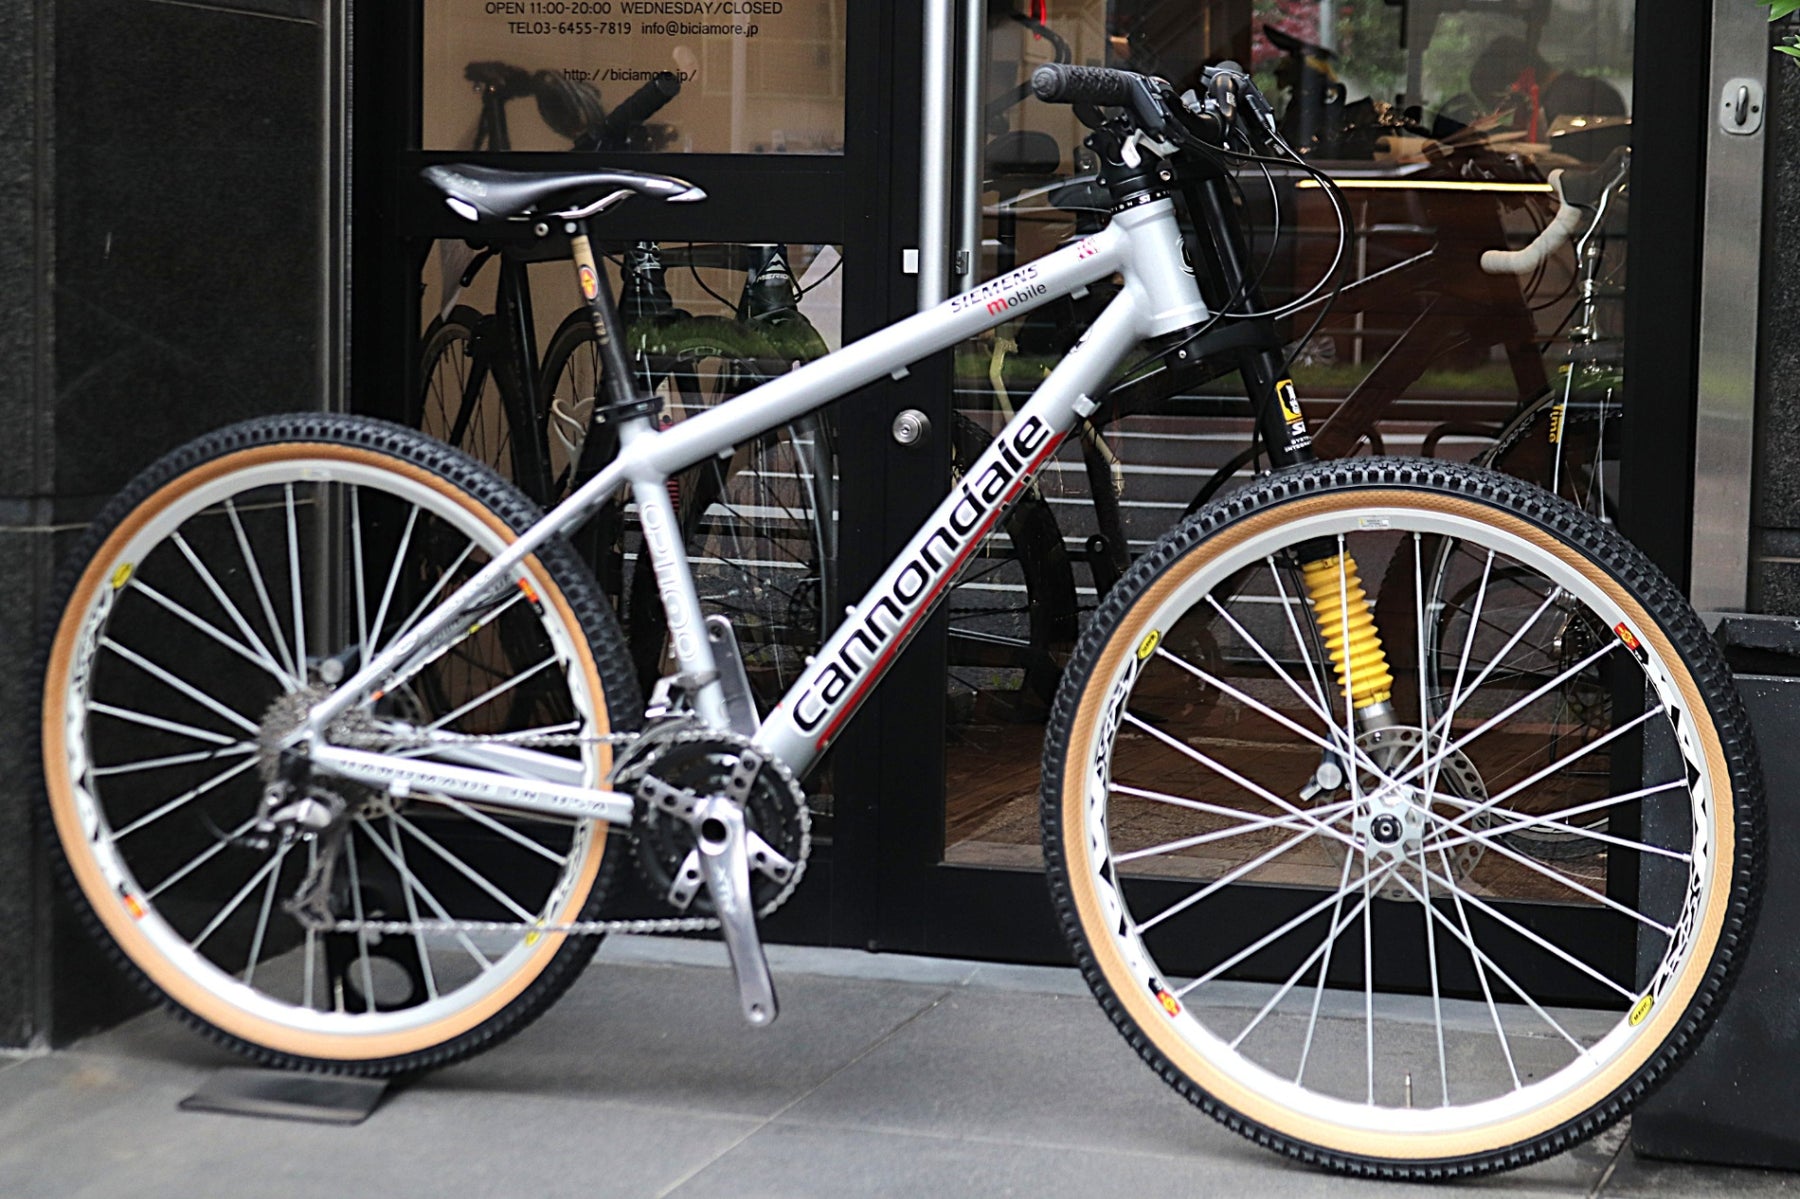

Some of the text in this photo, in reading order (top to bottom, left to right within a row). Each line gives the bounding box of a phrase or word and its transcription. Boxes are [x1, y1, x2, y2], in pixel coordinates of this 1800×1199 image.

[485, 1, 783, 15] OPEN 11:00-20:00 WEDNESDAY/CLOSED
[508, 21, 759, 37] TEL03-6455-7819 info@biciamore.jp
[756, 273, 790, 283] MERID
[950, 263, 1040, 313] SIEMENS
[985, 281, 1048, 316] mobile
[792, 414, 1056, 733] cannondale
